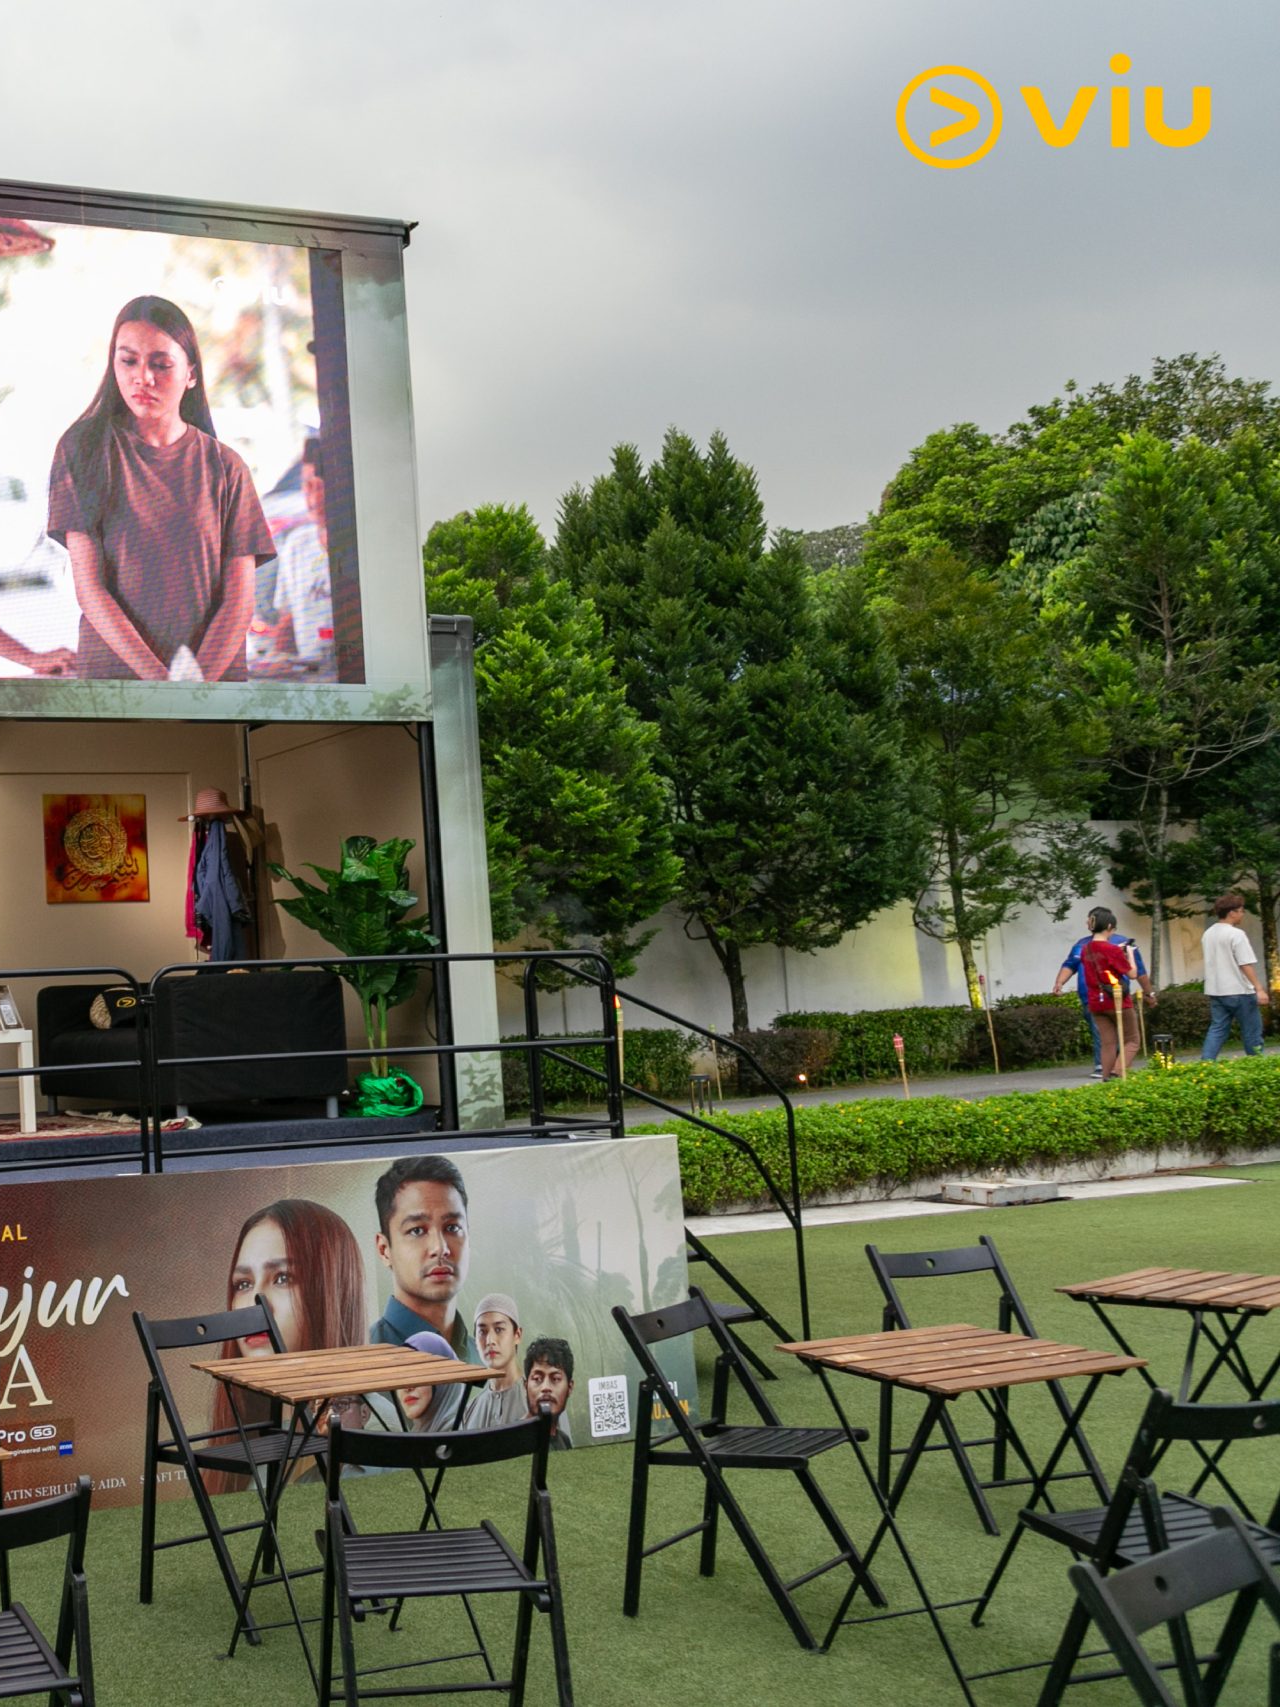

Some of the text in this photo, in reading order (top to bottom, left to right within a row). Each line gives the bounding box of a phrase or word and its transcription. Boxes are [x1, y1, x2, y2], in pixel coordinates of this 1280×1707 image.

[3, 1488, 32, 1501] ATIN
[35, 1485, 61, 1497] SERI
[98, 1477, 127, 1491] AIDA
